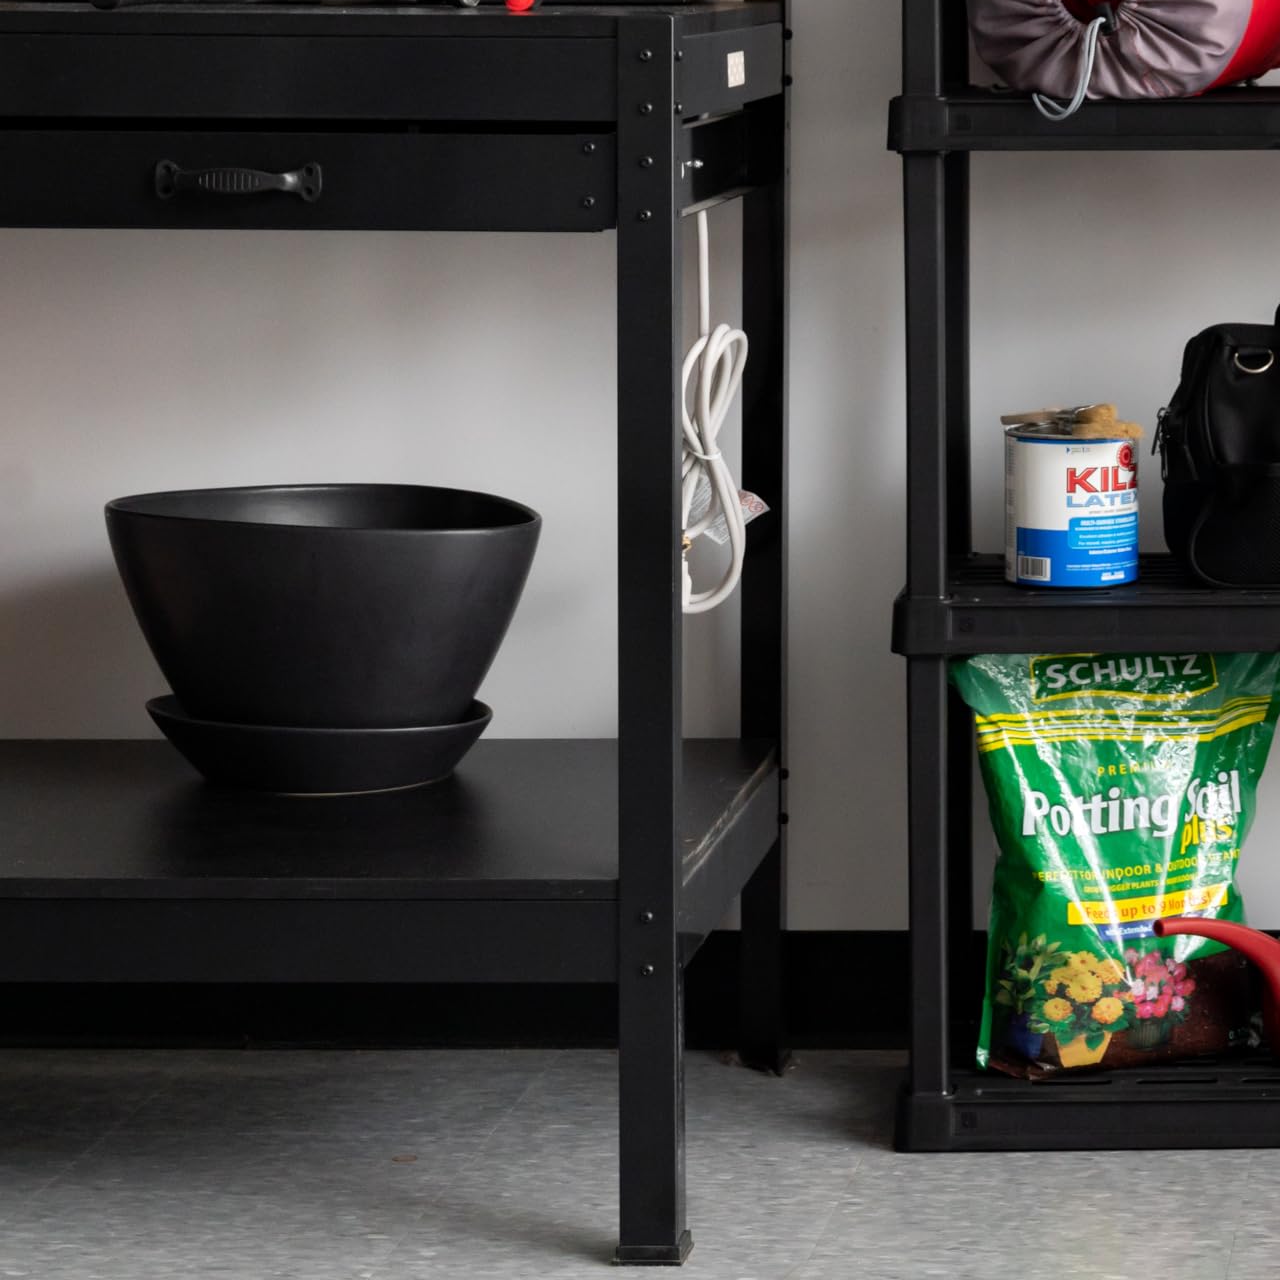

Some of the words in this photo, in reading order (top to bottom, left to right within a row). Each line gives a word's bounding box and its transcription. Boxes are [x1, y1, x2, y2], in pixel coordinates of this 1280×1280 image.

[1045, 654, 1202, 689] SCHULTZ
[1022, 786, 1179, 838] Potting
[1184, 770, 1242, 822] Soil
[1180, 814, 1233, 855] plus
[1167, 856, 1201, 872] OUTDOO
[1121, 906, 1138, 920] up
[1141, 903, 1156, 915] to
